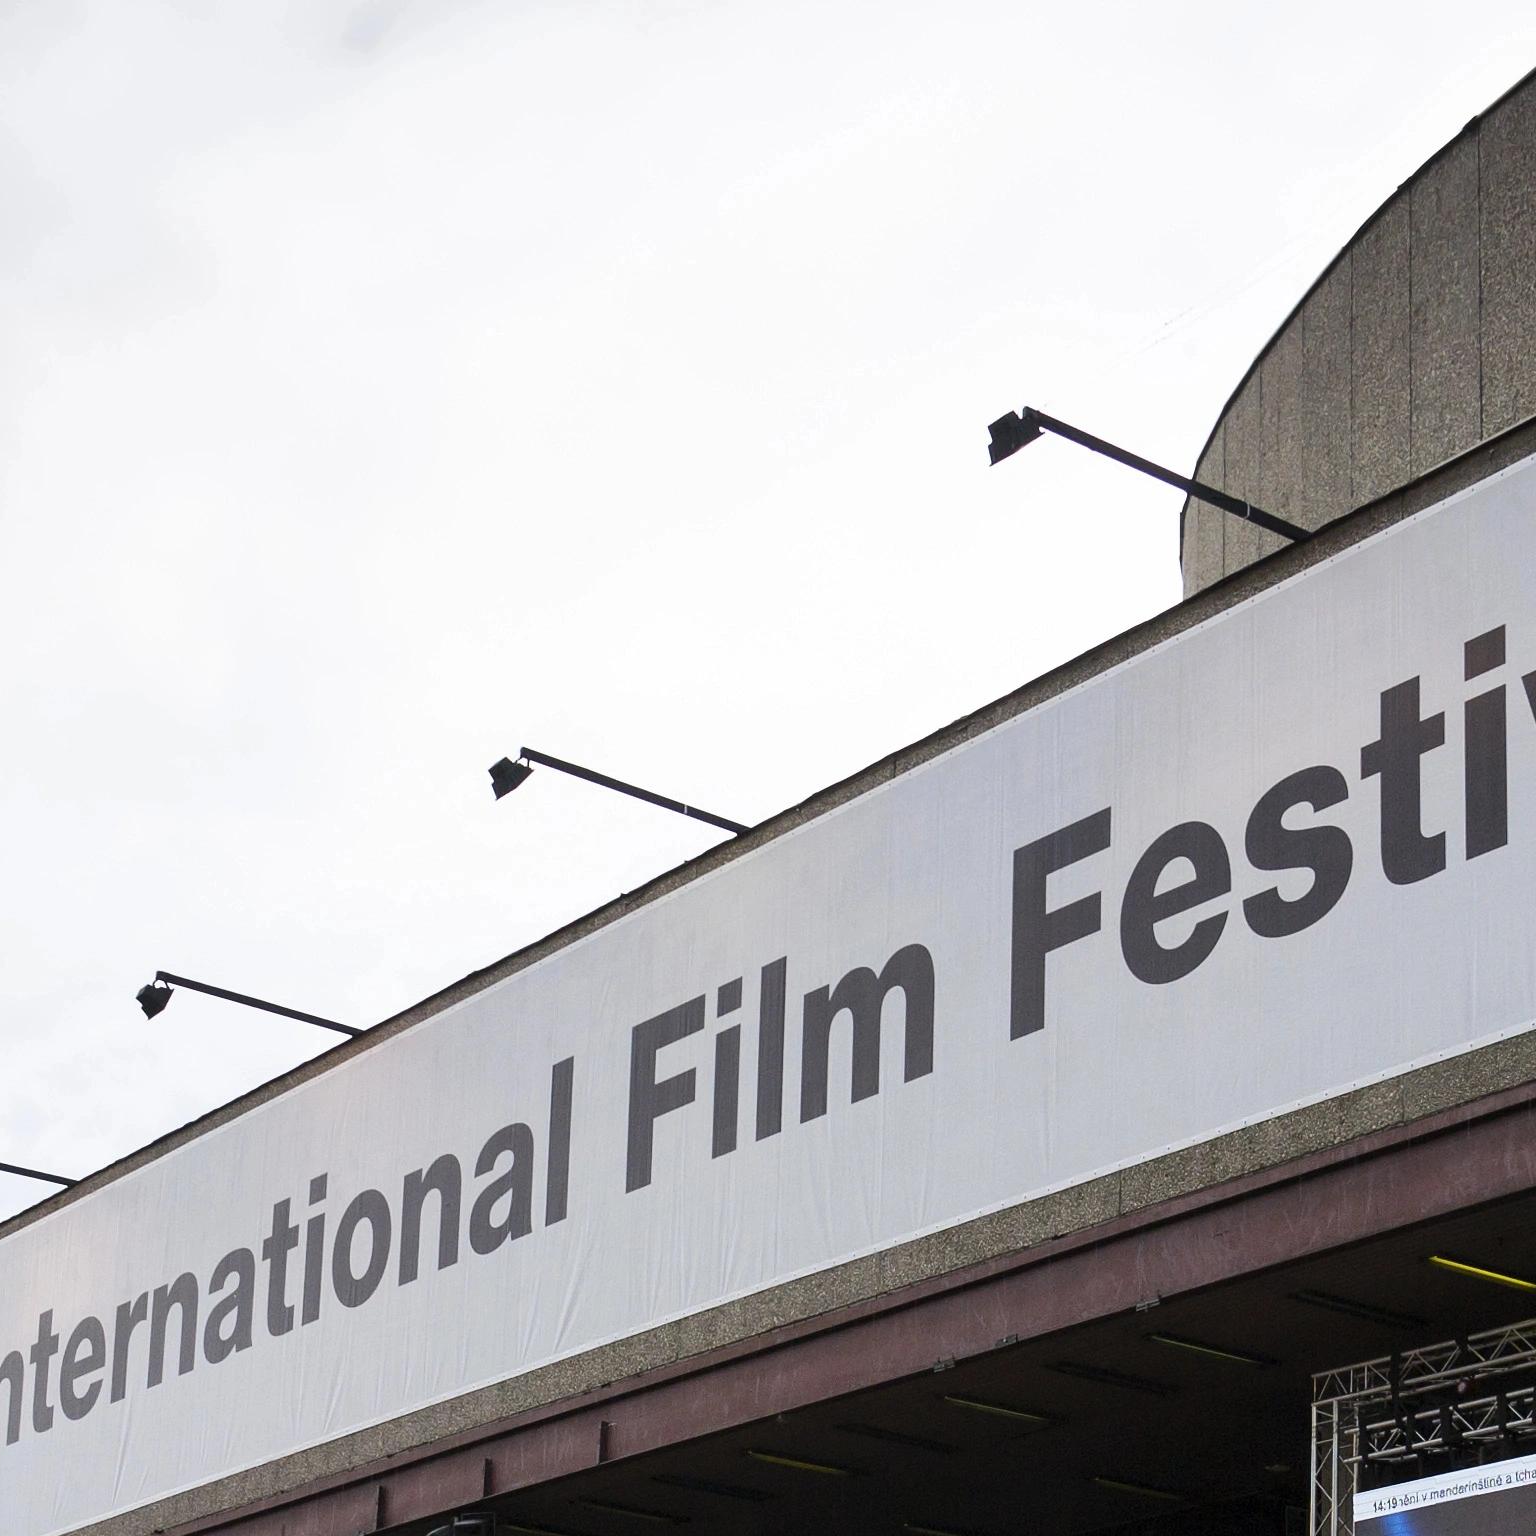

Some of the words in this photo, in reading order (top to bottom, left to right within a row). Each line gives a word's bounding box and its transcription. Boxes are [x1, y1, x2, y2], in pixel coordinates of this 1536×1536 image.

[626, 944, 935, 1194] Film
[1372, 1497, 1398, 1513] 14:19
[1505, 1475, 1512, 1484] a
